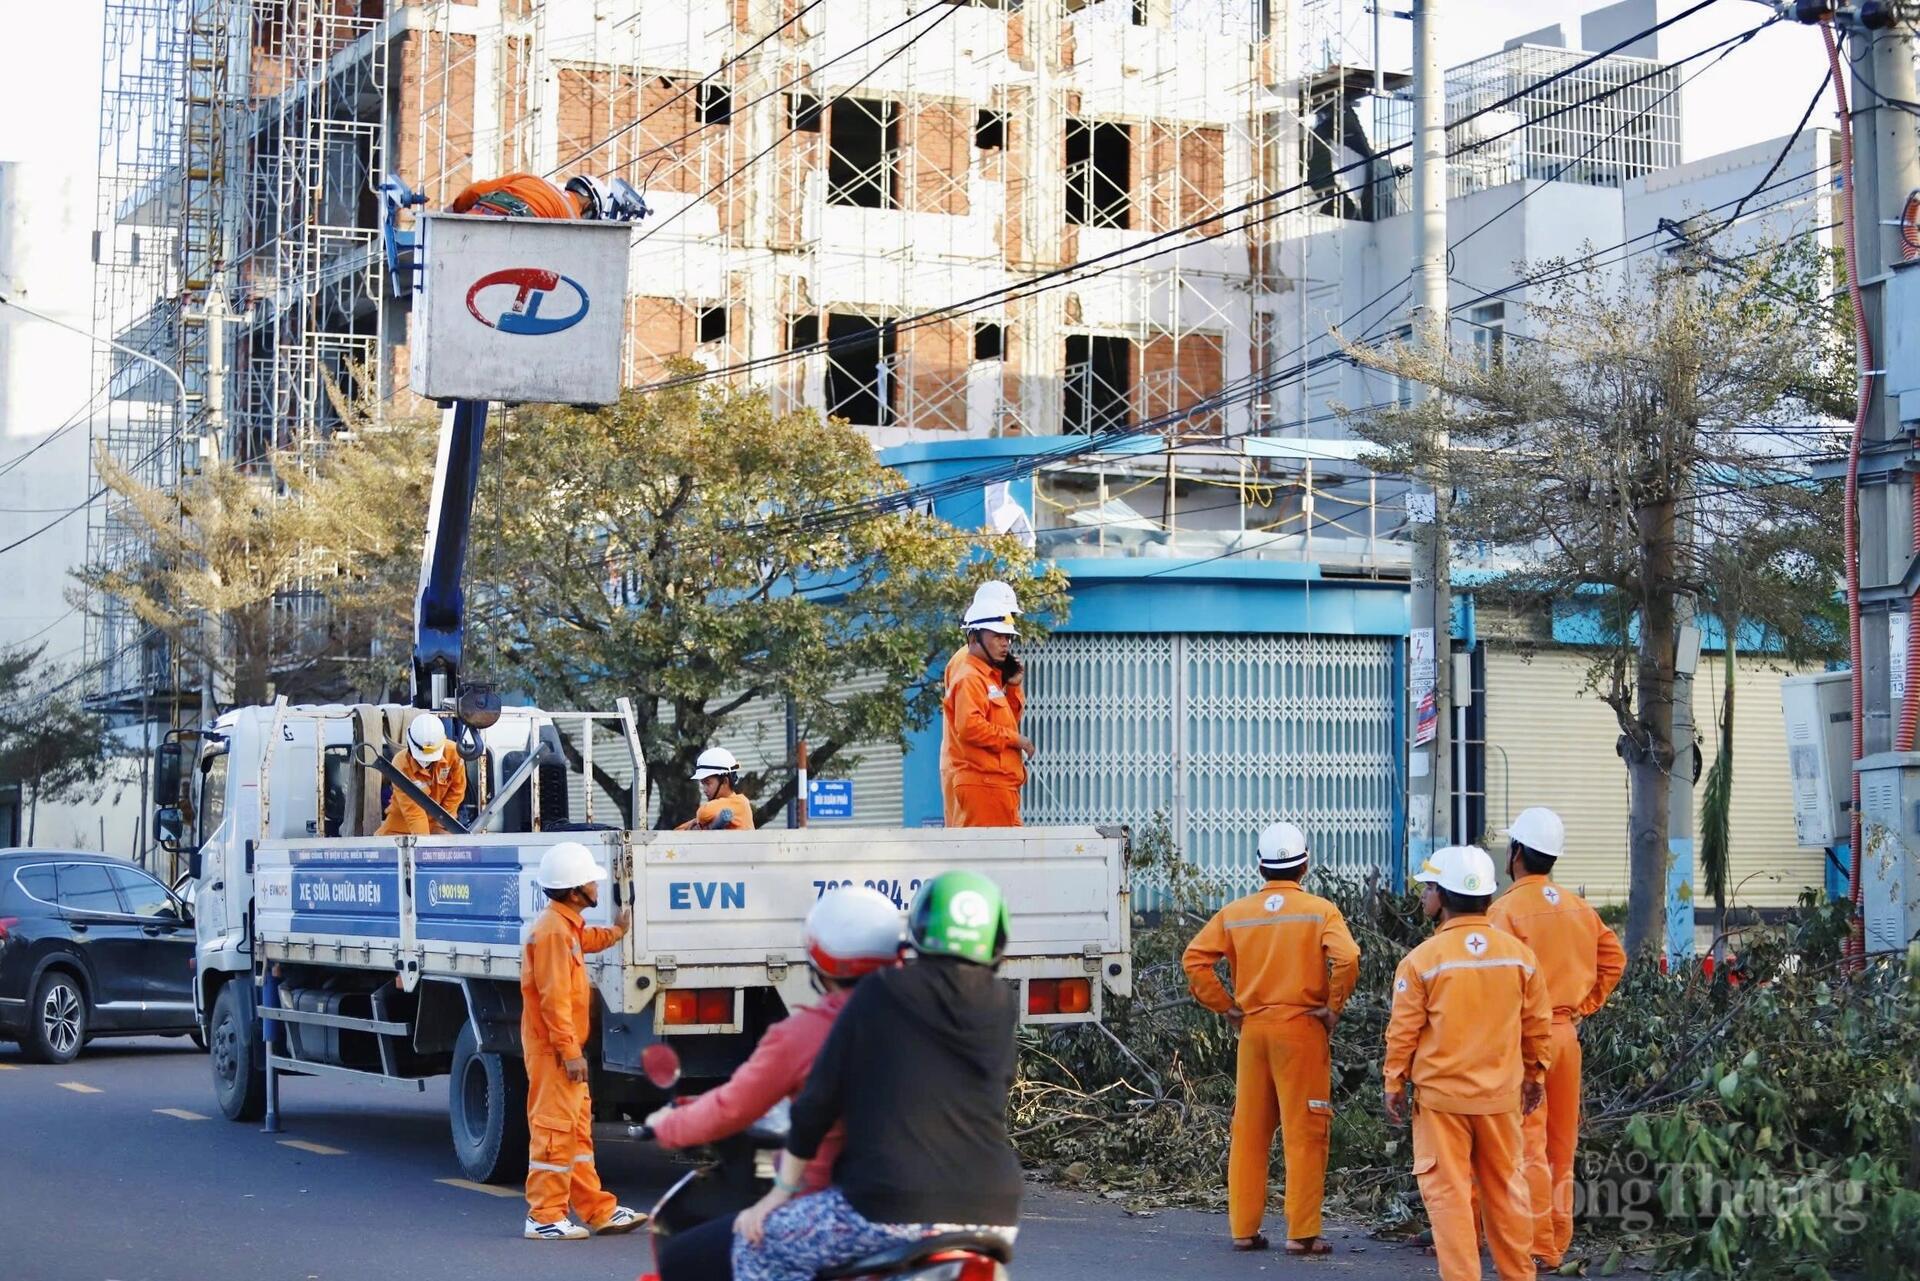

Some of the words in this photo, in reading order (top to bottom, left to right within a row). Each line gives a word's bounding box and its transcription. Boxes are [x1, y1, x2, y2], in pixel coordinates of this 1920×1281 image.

[299, 883, 312, 901] XE
[332, 880, 356, 902] CHỮA
[358, 880, 380, 907] ĐIỆN
[439, 884, 470, 900] 19001909
[669, 882, 745, 910] EVN
